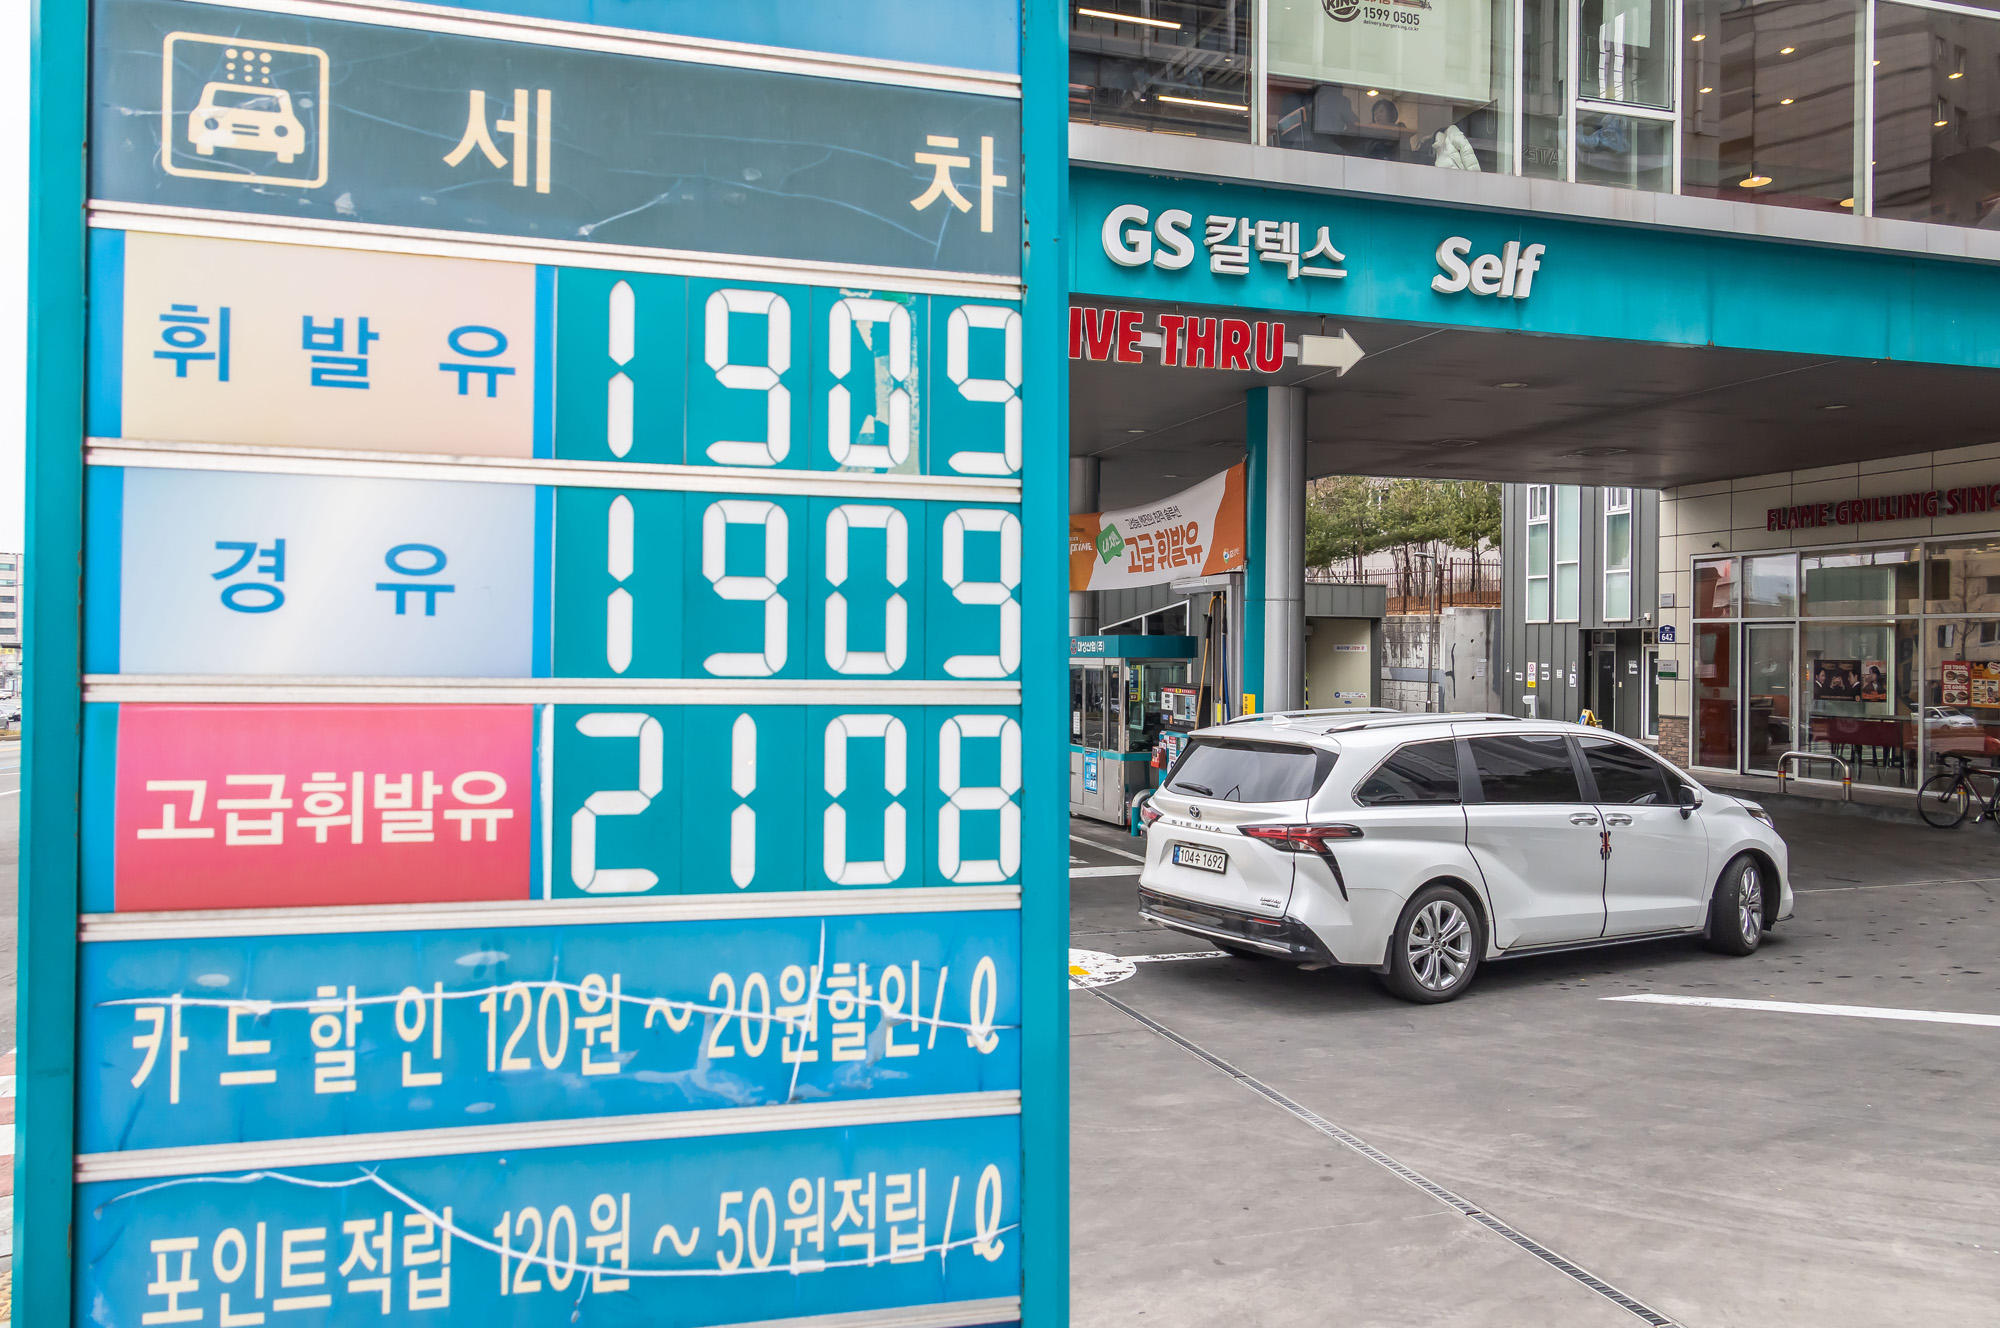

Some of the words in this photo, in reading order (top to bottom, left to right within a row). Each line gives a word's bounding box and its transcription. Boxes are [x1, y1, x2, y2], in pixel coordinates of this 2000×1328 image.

[1363, 7, 1390, 21] 1599
[1393, 11, 1420, 25] 0505
[1431, 236, 1546, 299] Self
[1156, 313, 1286, 374] THRU
[608, 280, 1022, 475] 1909
[1766, 502, 1830, 532] FLAME
[1835, 490, 1939, 525] GRILLING
[607, 494, 1022, 678] 1909
[1661, 633, 1673, 641] 642
[137, 770, 514, 846] 고급휘발유
[571, 712, 1022, 893] 2108
[1172, 819, 1221, 832] SIENNA
[1203, 853, 1224, 869] 1692
[480, 973, 622, 1077] 120원
[141, 1206, 452, 1328] 포인트적립
[494, 1193, 630, 1297] 120원
